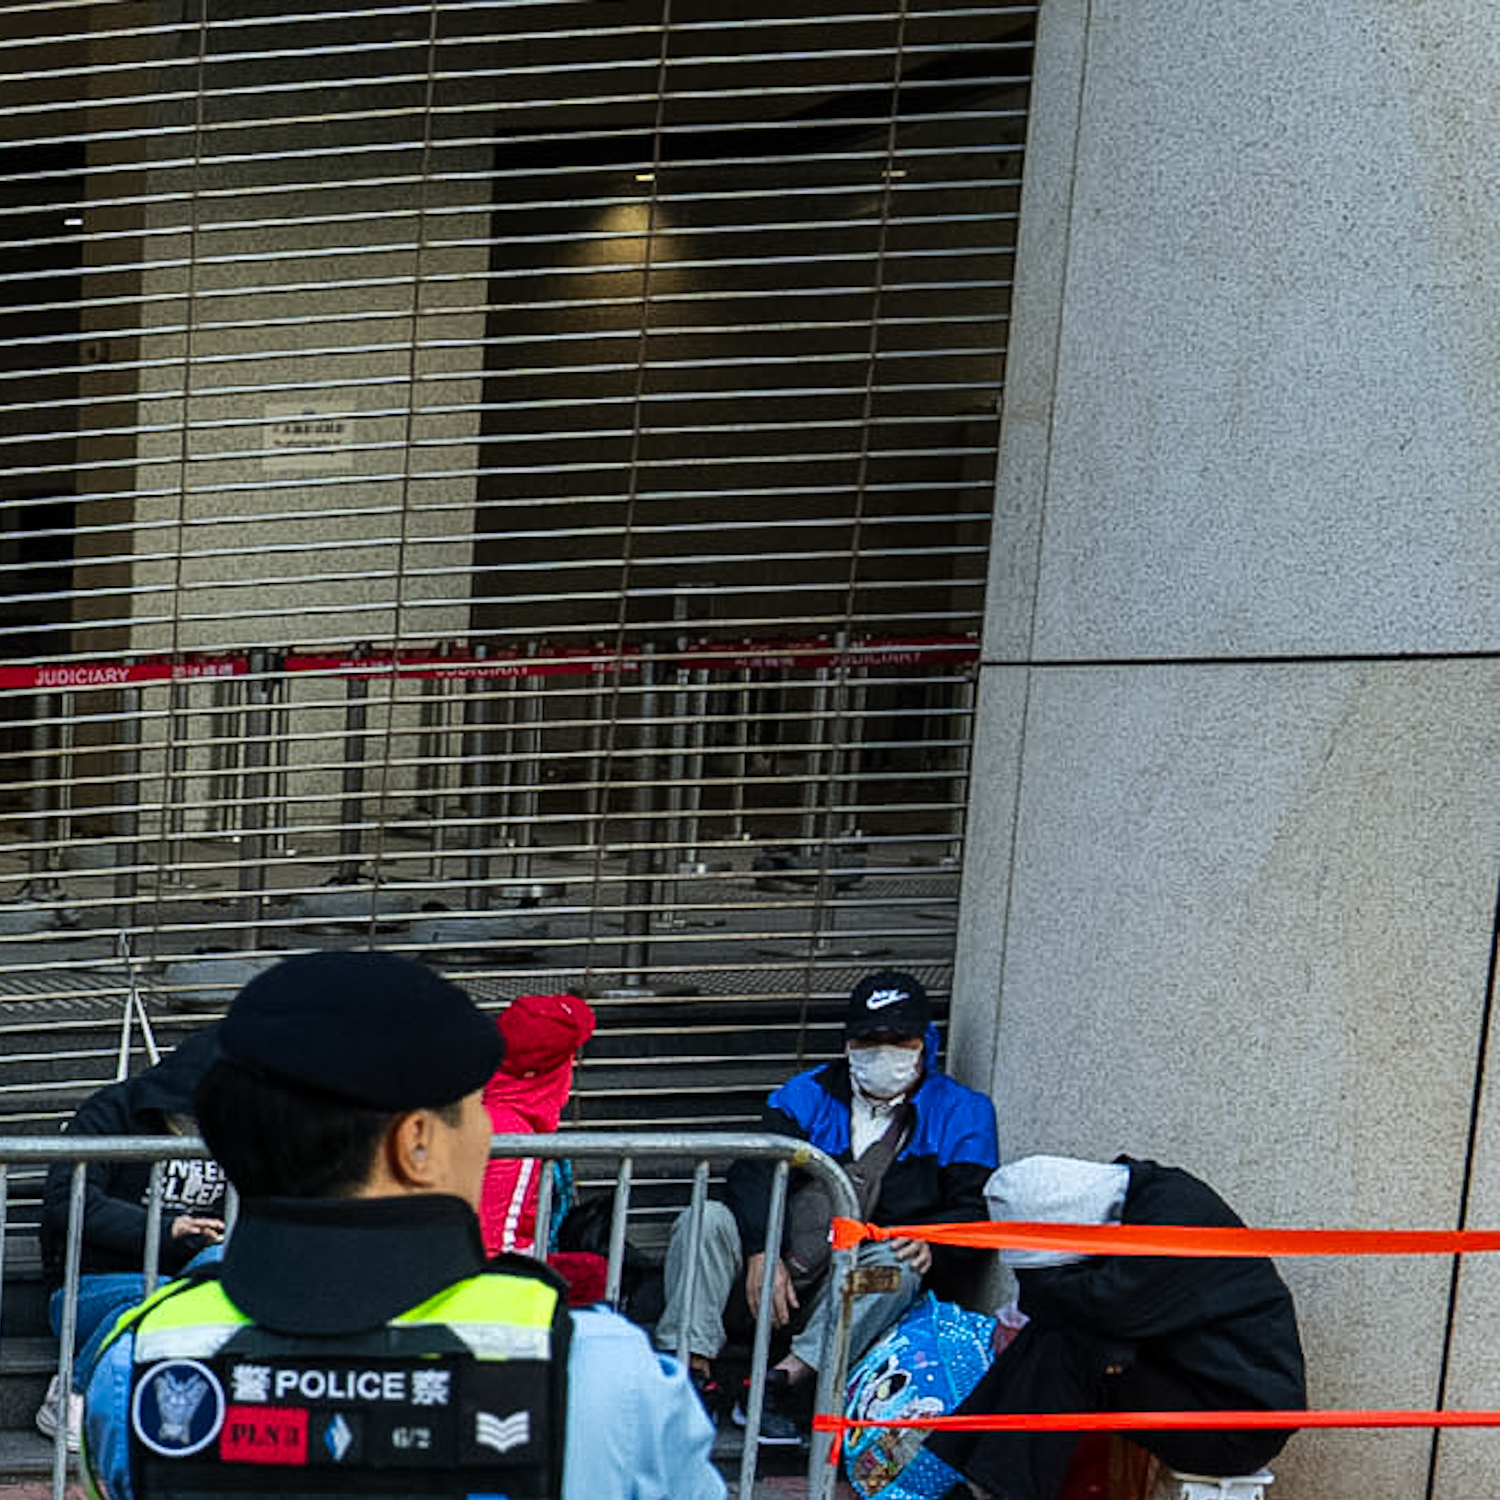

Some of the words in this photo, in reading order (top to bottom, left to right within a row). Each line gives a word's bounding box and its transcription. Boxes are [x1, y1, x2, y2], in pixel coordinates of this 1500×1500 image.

[34, 667, 129, 686] JUDICIARY
[233, 1364, 271, 1401] 警
[275, 1369, 406, 1399] POLICE
[411, 1370, 451, 1405] 察
